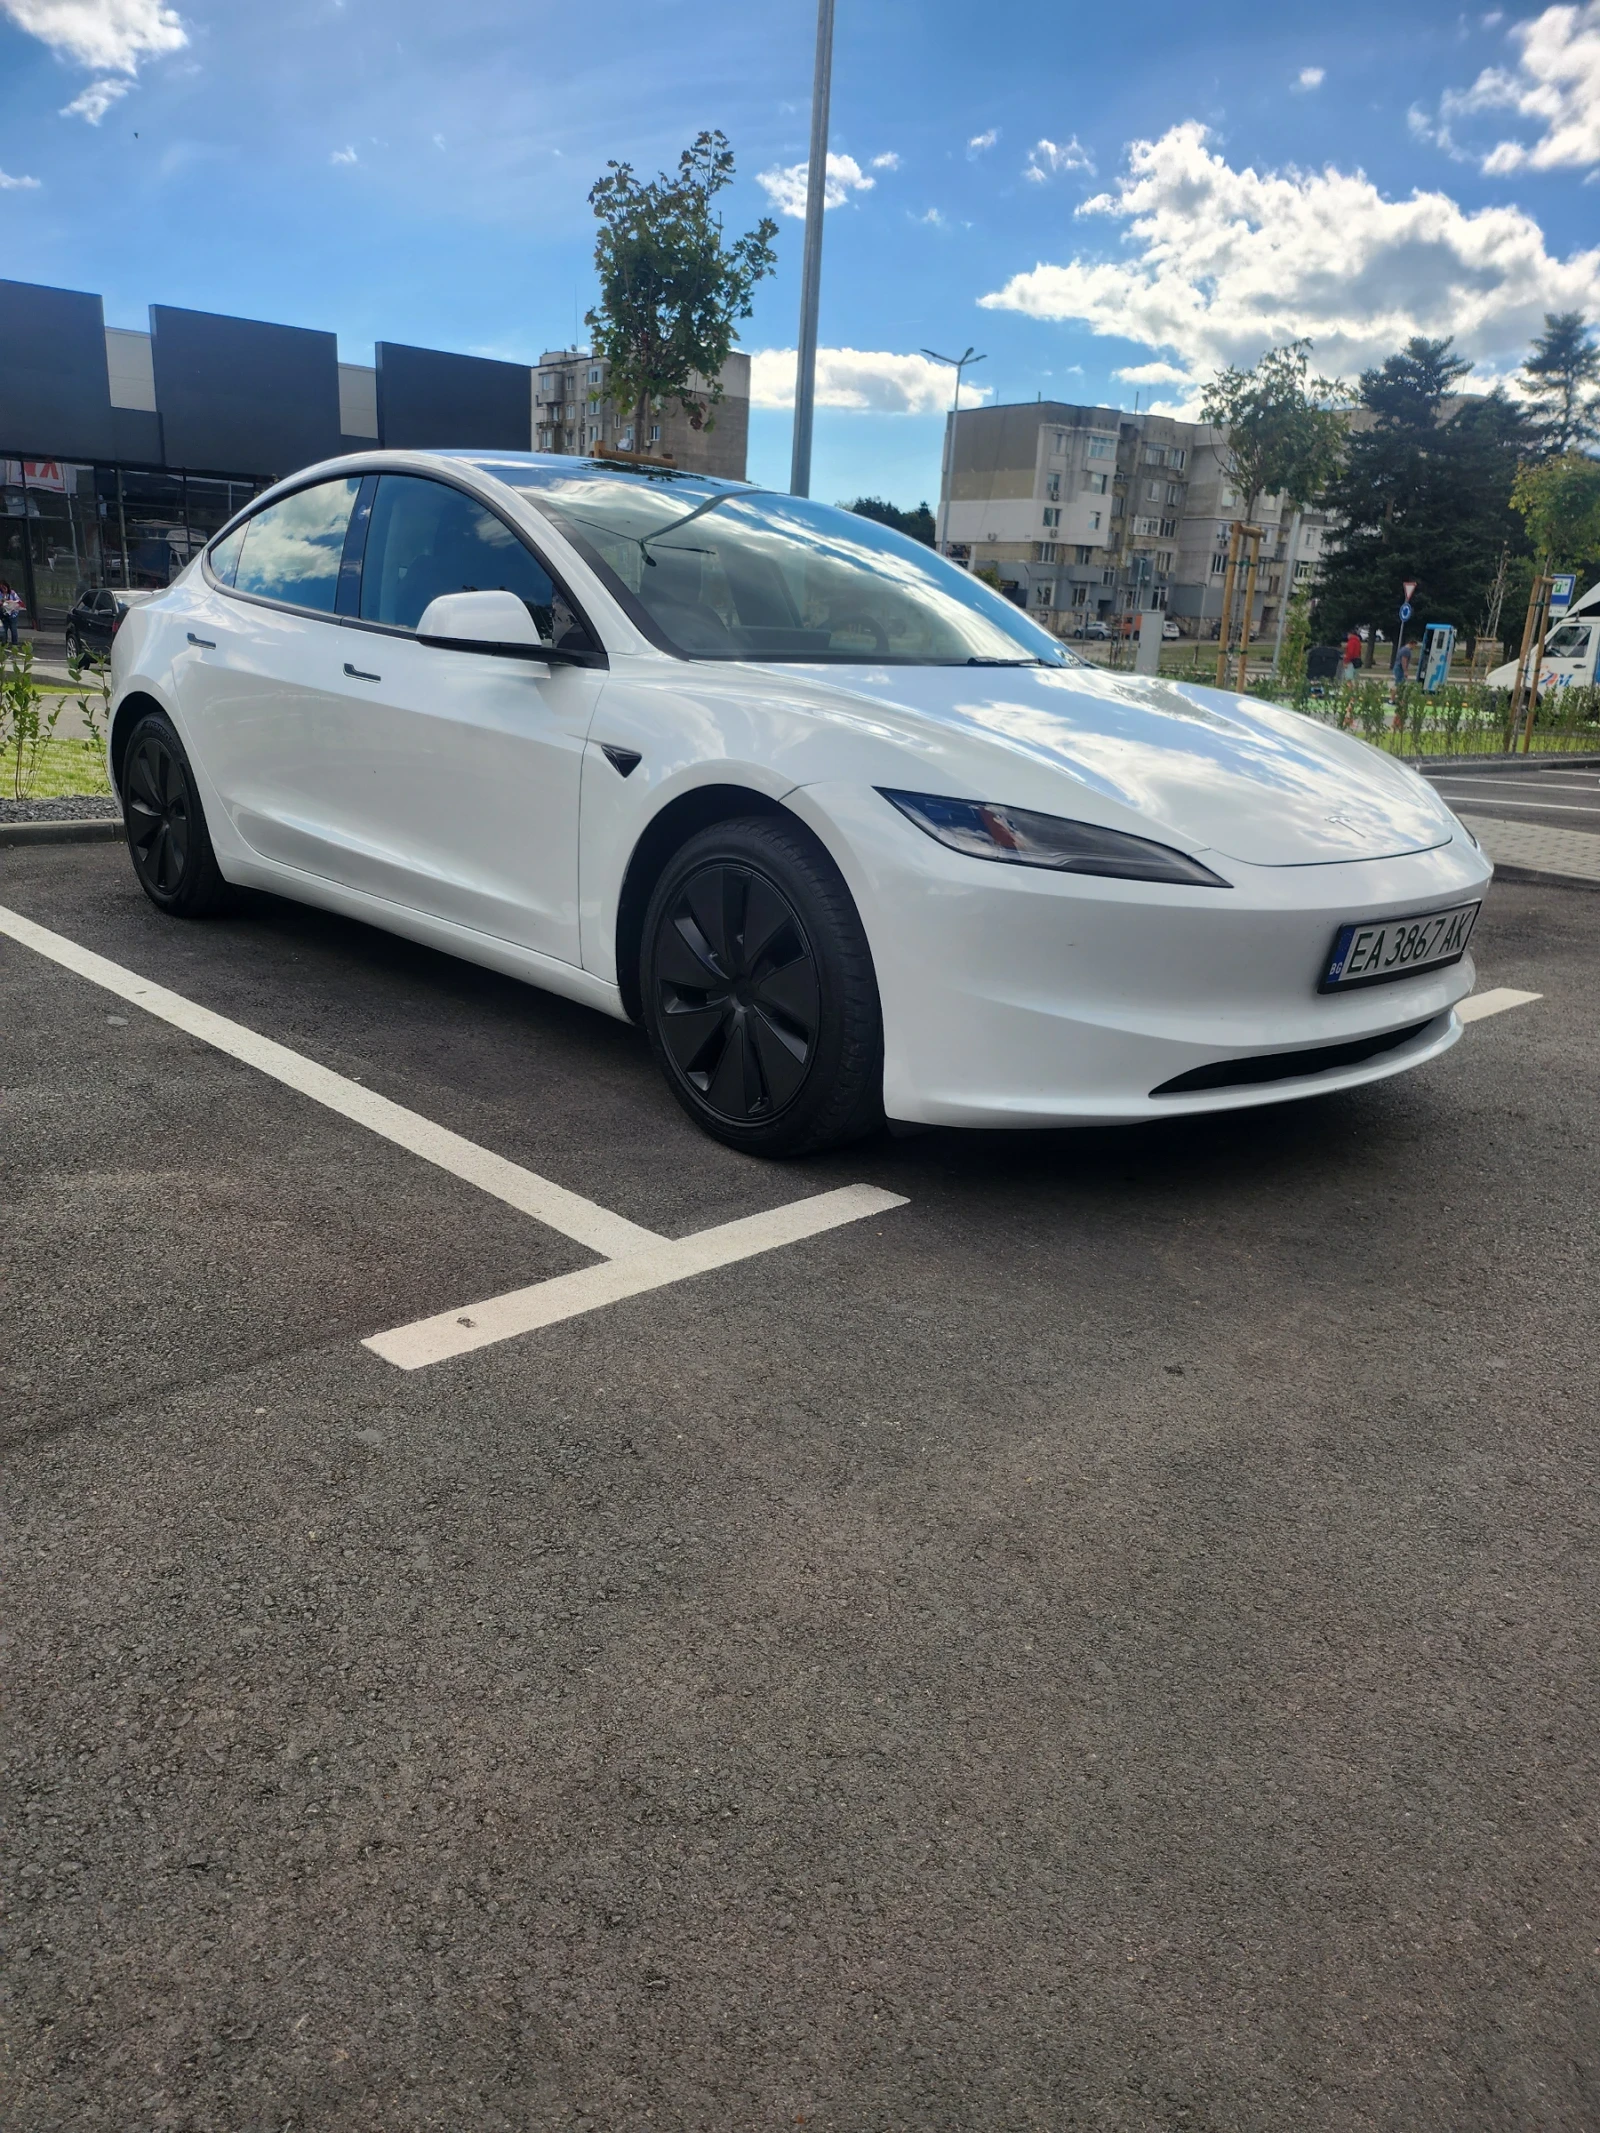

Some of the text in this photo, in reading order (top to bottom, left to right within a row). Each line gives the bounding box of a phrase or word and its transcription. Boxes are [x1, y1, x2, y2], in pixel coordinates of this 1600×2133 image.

[1346, 910, 1473, 974] EA 3867 AK
[1329, 962, 1343, 976] BG
